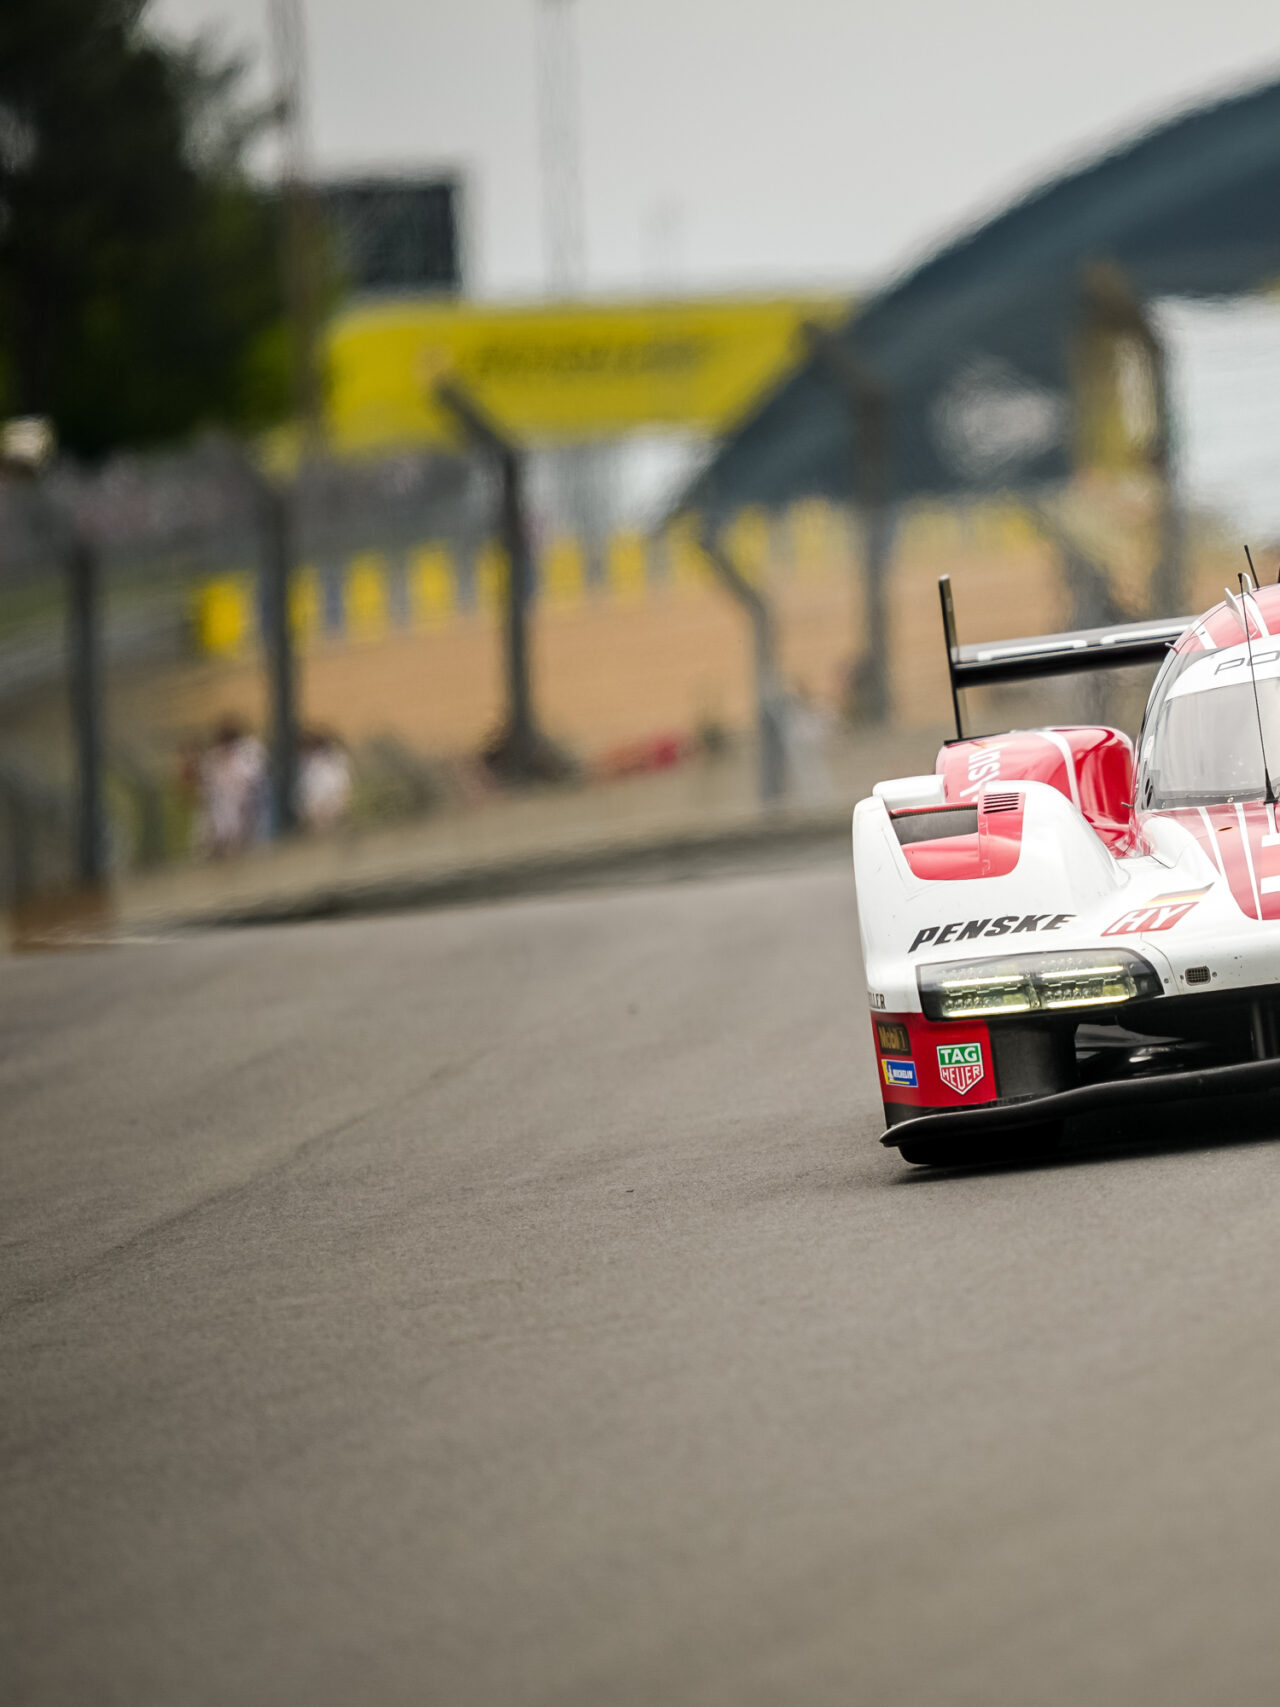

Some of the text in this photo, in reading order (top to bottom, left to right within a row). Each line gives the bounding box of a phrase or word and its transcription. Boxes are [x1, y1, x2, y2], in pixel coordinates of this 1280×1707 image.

[1106, 903, 1190, 933] HY
[908, 914, 1077, 954] PENSKE
[940, 1047, 978, 1065] TAG
[941, 1065, 981, 1091] HEUER
